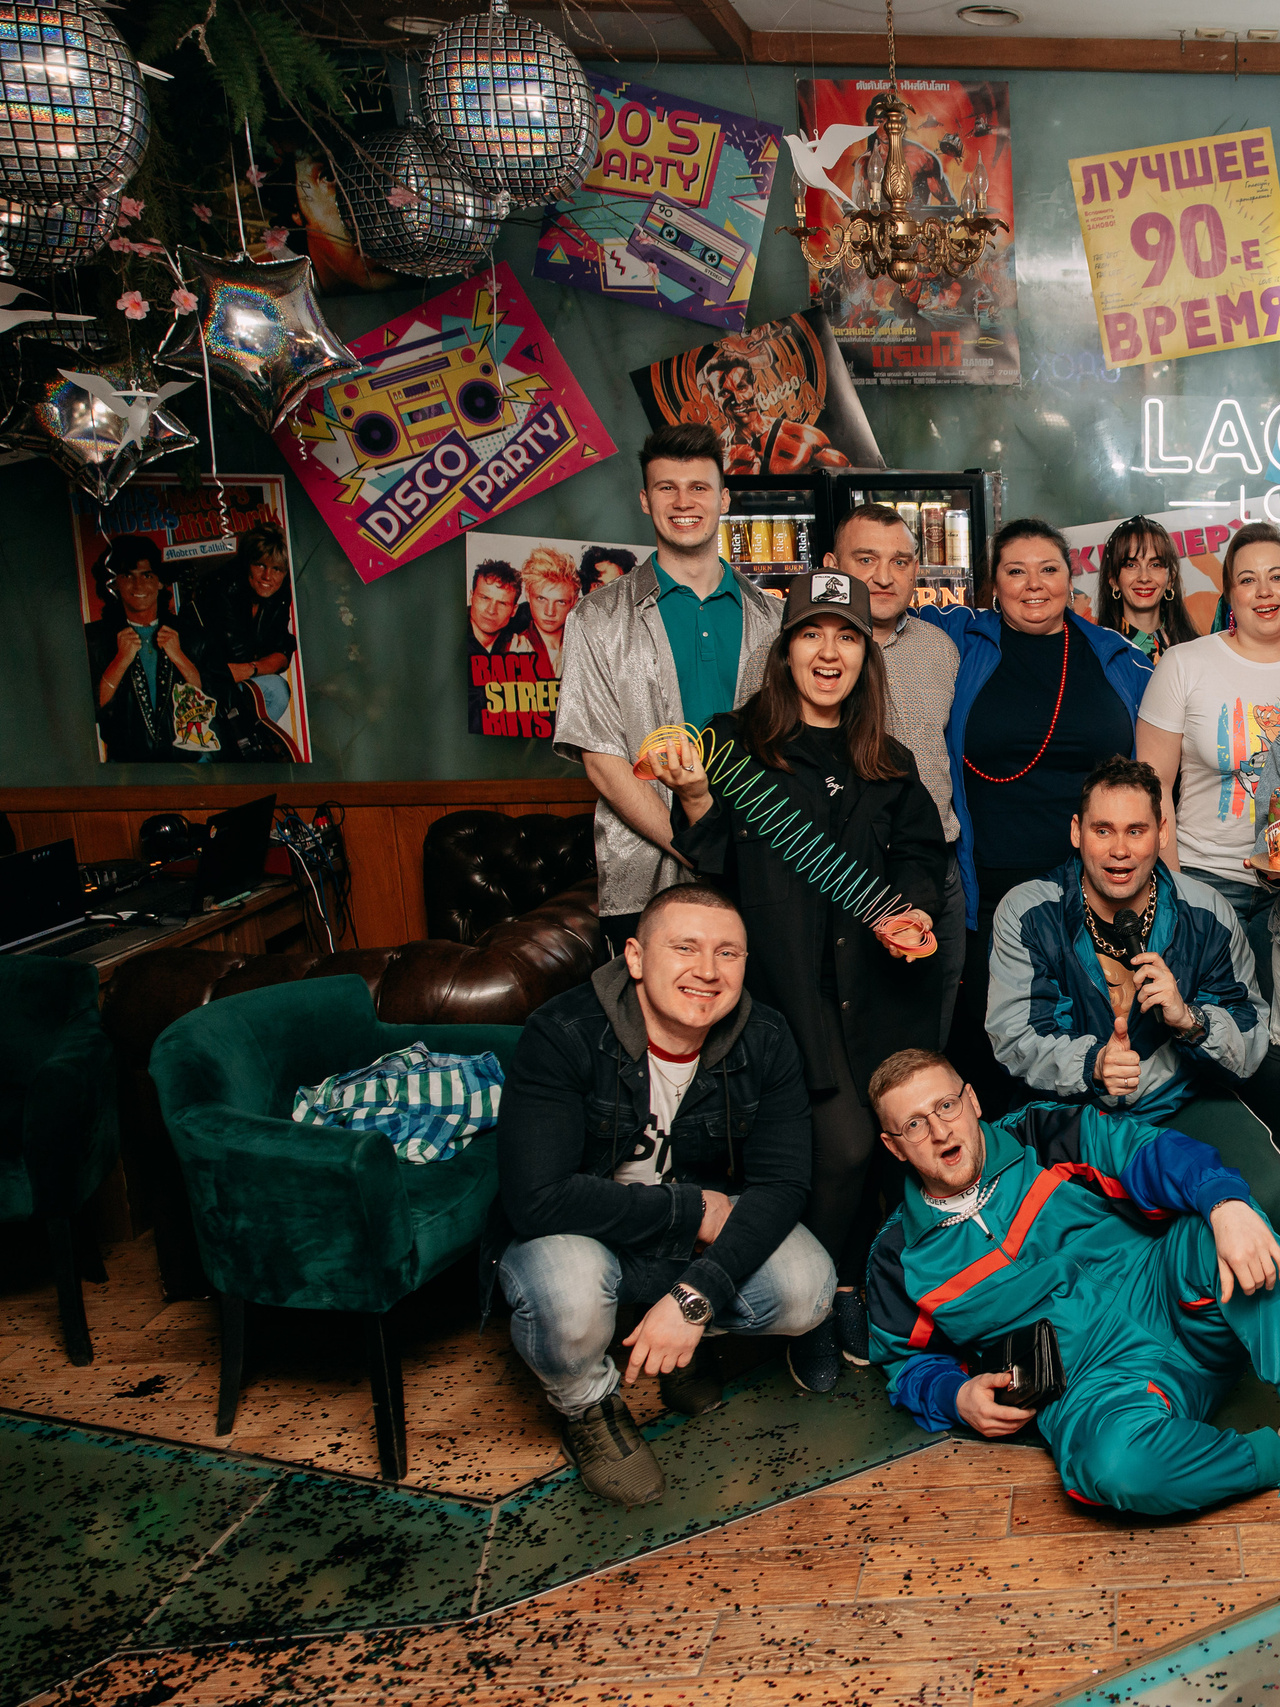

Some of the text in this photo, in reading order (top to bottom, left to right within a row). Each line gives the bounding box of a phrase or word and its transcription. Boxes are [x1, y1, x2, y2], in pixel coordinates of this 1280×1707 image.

[593, 148, 700, 191] ARTY
[1081, 137, 1270, 206] ЛУЧШЕЕ
[658, 205, 673, 218] 90
[962, 358, 994, 367] RAMBO
[467, 412, 561, 504] PARTY
[366, 444, 468, 544] DISCO
[166, 547, 199, 560] Modern
[733, 533, 741, 553] Rich
[776, 532, 784, 552] Rich
[798, 532, 807, 552] Rich
[471, 654, 538, 686] BACK
[485, 681, 560, 713] STREE
